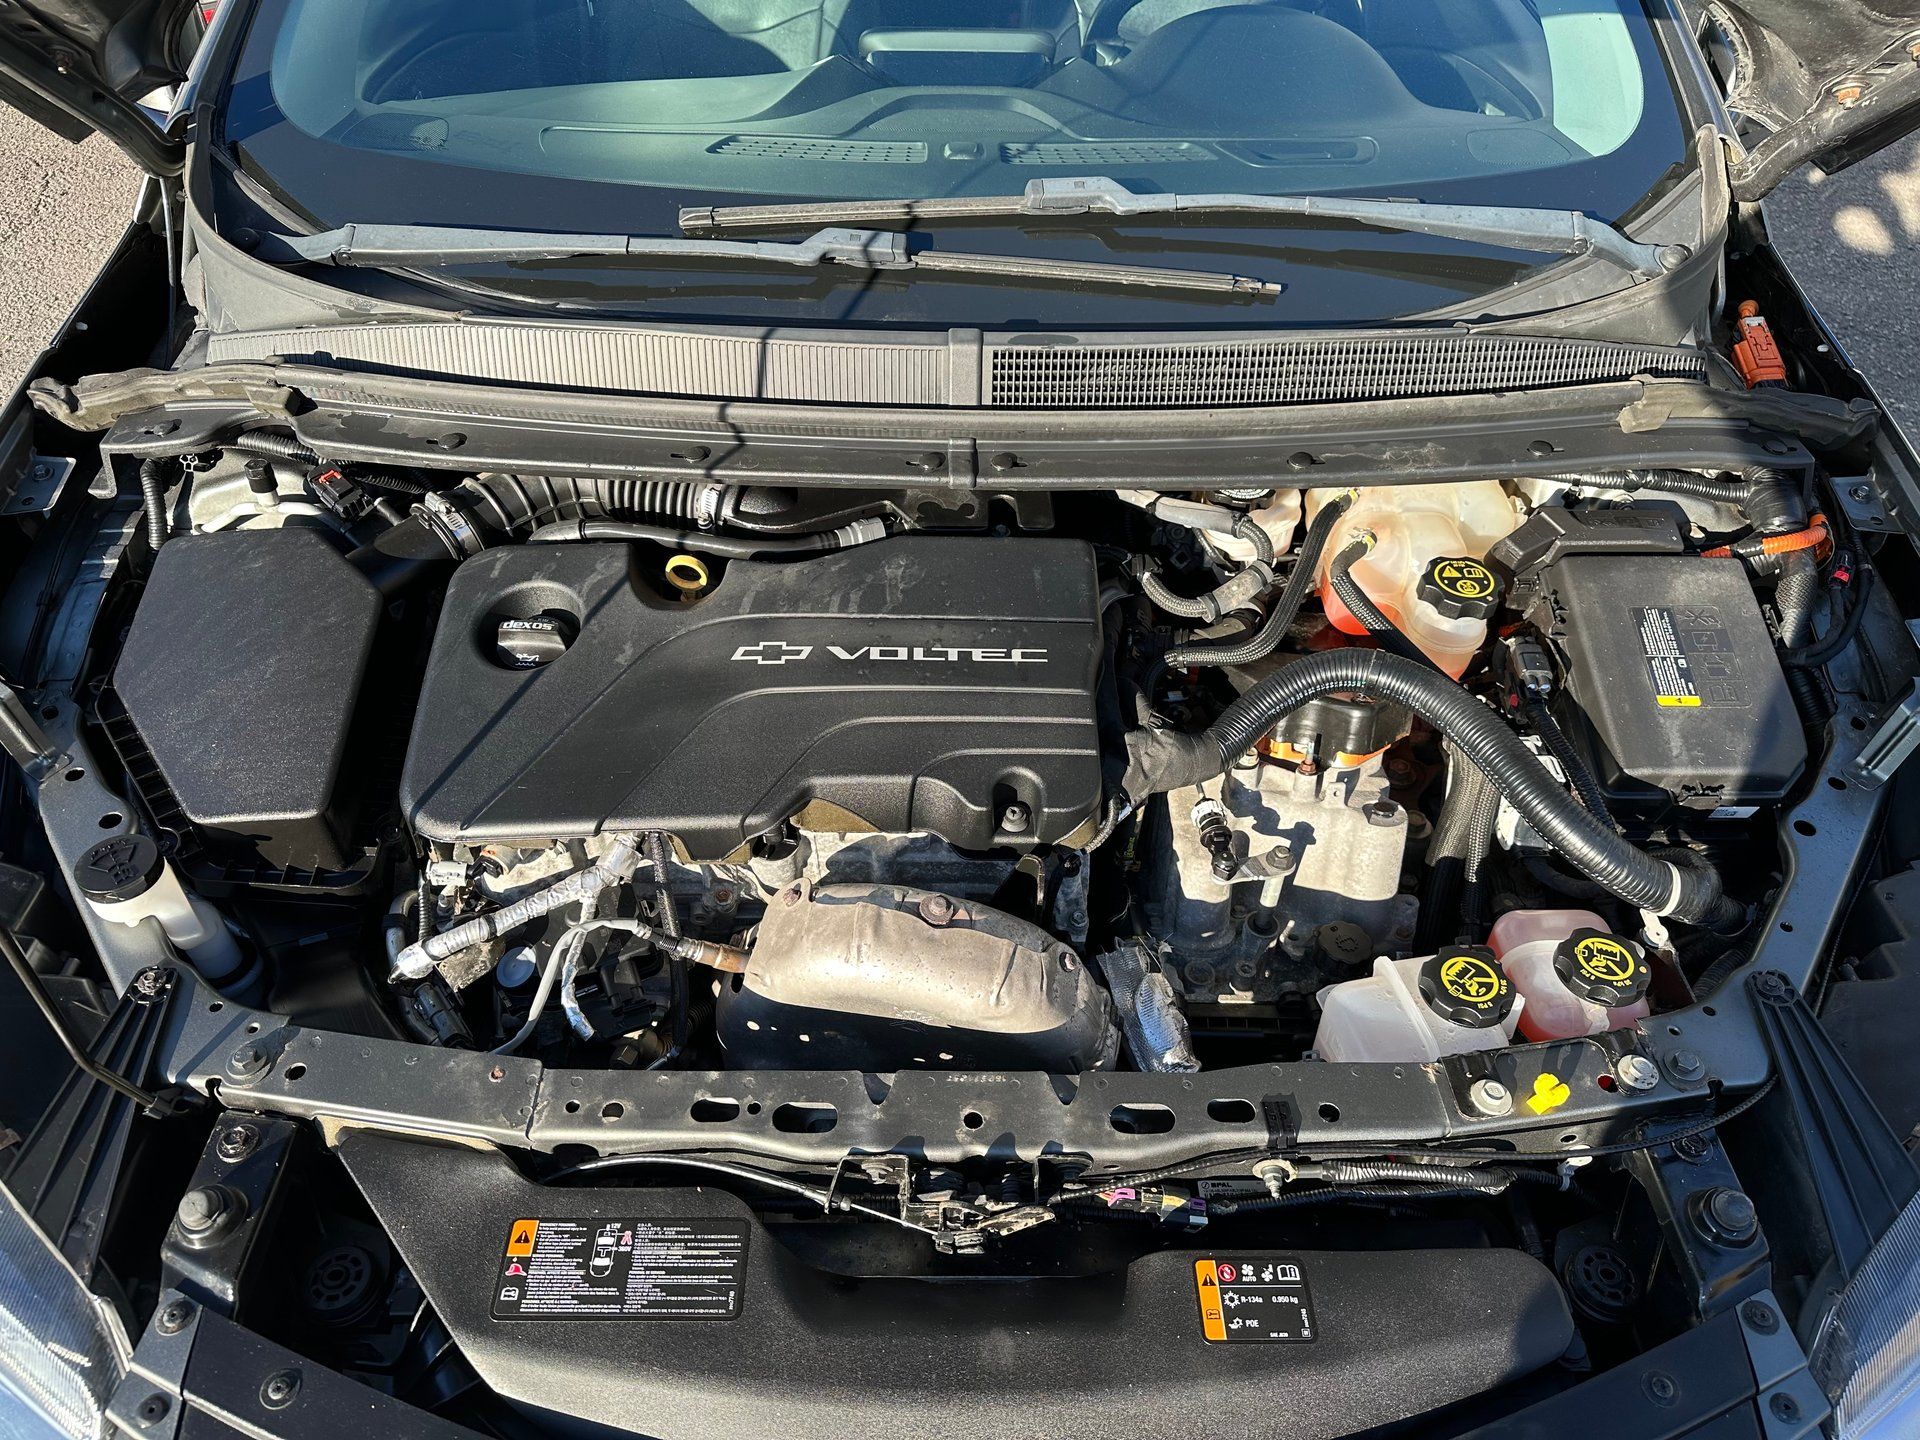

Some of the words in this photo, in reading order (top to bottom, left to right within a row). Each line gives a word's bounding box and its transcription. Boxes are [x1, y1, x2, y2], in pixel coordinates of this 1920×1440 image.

[502, 619, 555, 631] dexos
[825, 645, 1048, 663] VOLTEC
[1271, 1295, 1289, 1303] 0.950
[1289, 1296, 1299, 1304] kg
[1245, 1319, 1260, 1327] POE
